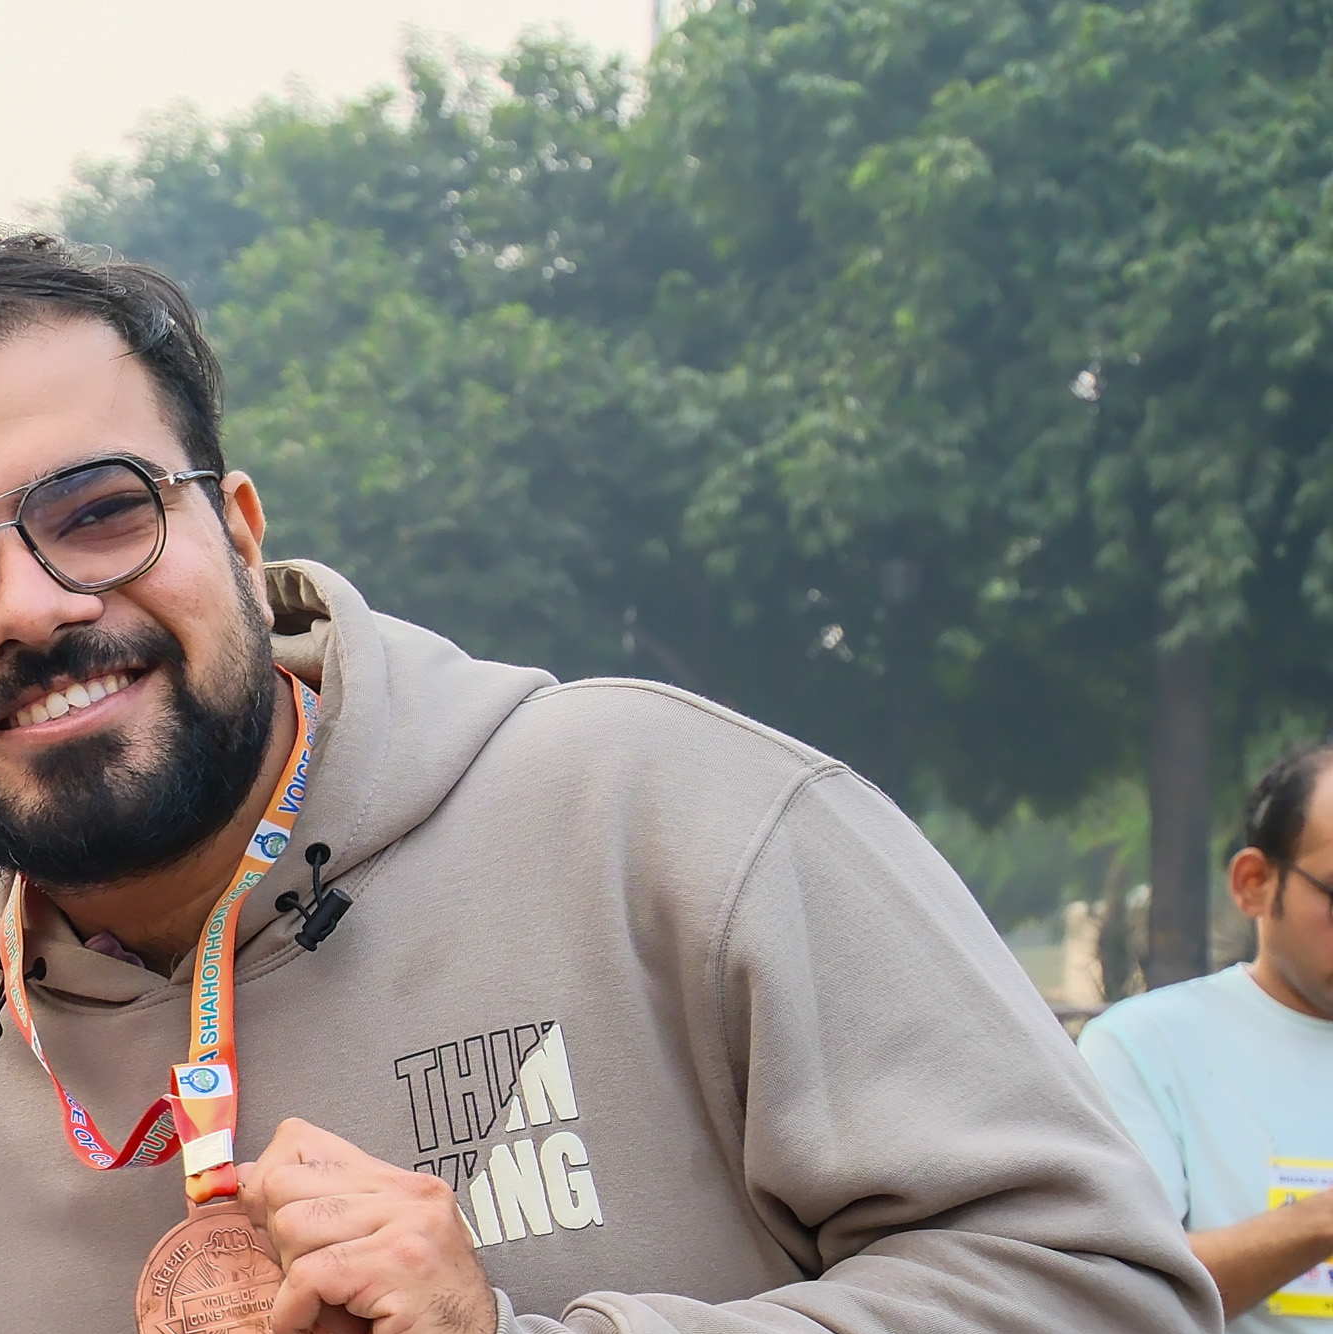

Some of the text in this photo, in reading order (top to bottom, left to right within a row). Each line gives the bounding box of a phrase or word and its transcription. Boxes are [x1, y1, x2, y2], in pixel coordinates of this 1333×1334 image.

[199, 901, 231, 1046] SHAHOTHON
[394, 1019, 579, 1153] THIN
[74, 1129, 103, 1152] OF
[202, 1289, 259, 1309] VOICE OF
